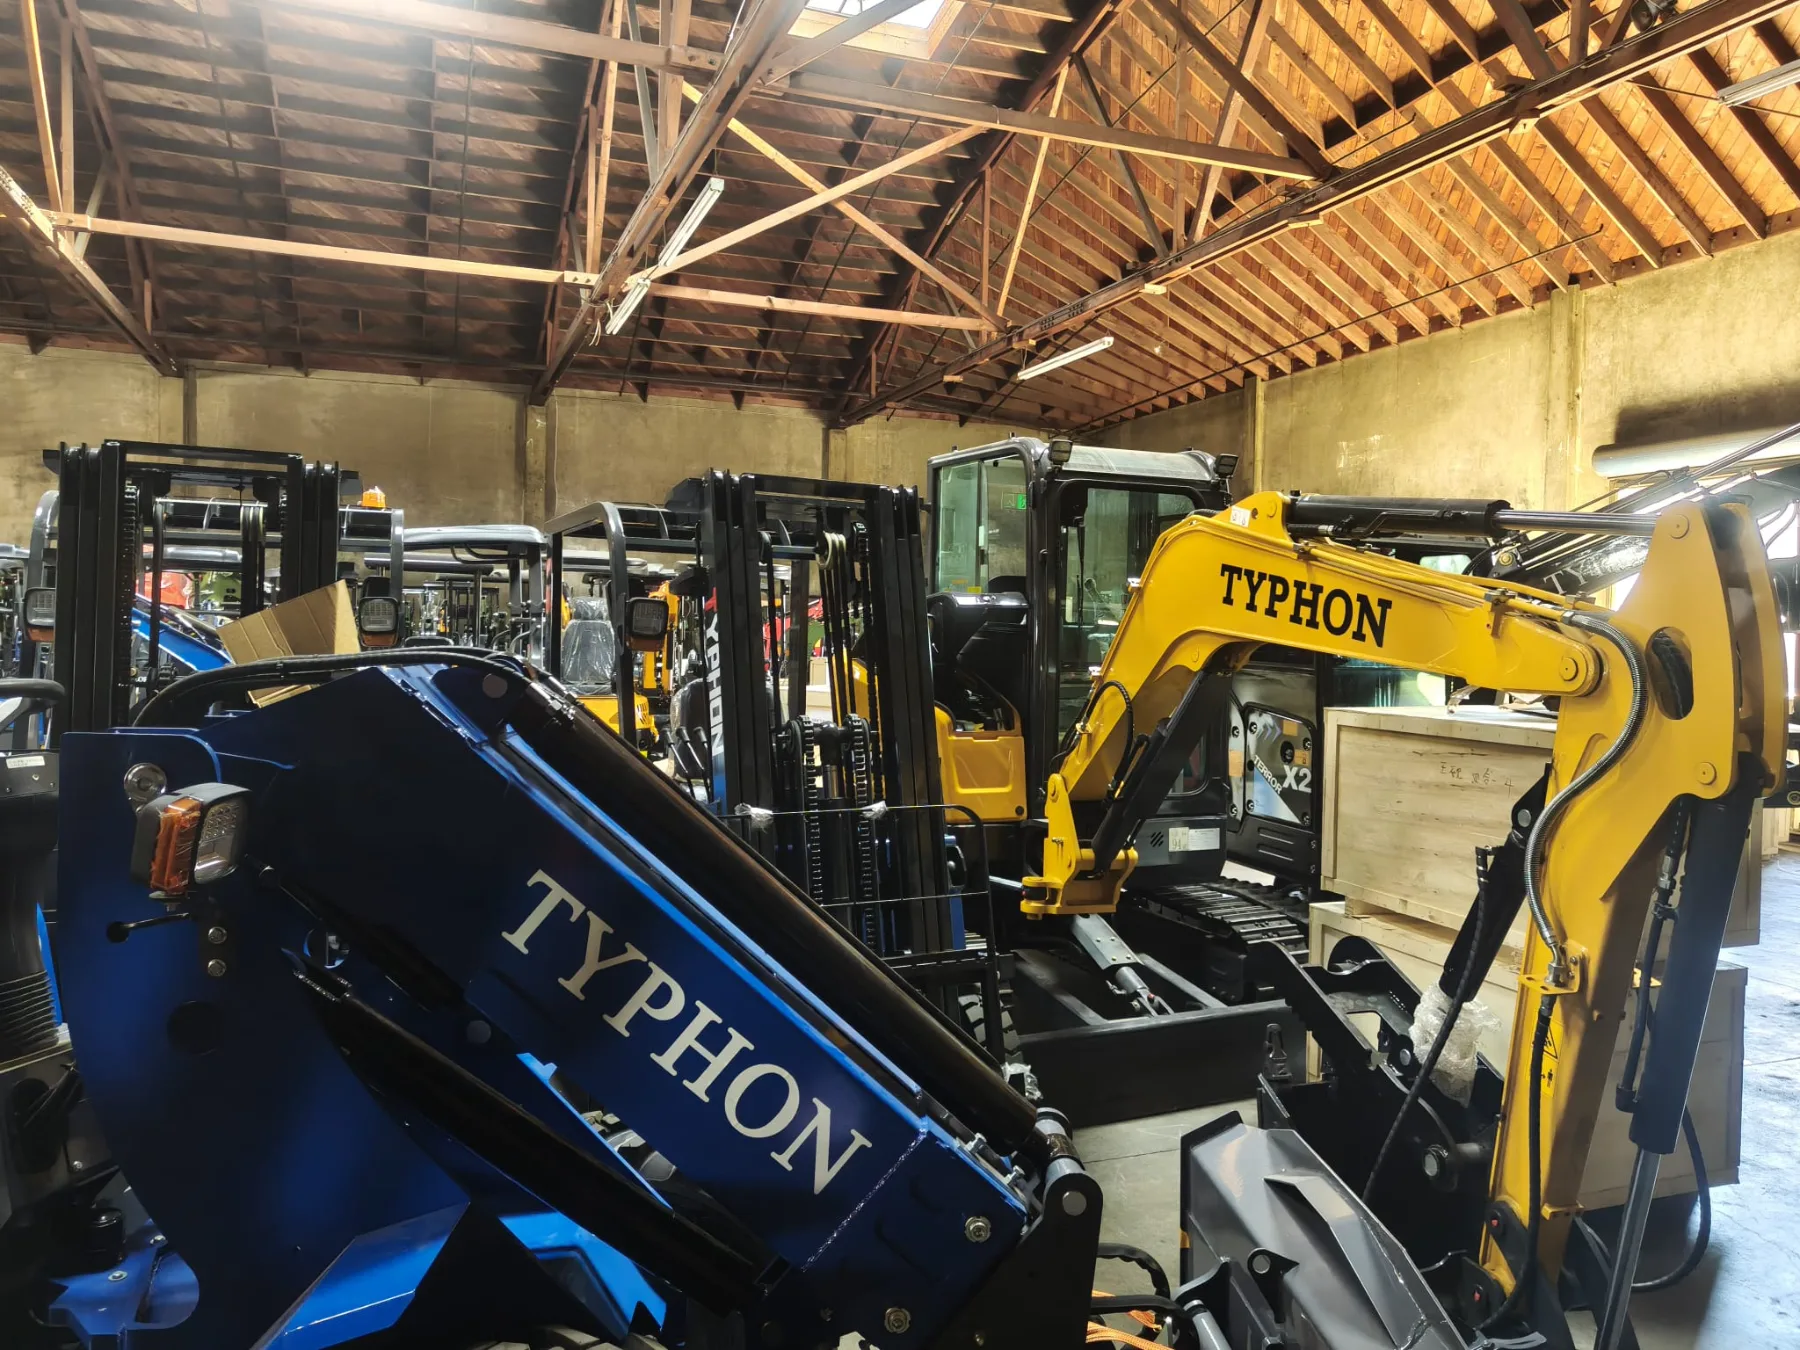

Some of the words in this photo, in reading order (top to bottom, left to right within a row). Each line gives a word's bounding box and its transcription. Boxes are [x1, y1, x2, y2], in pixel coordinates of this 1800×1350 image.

[1220, 563, 1392, 648] TYPHON
[1253, 754, 1283, 795] TERROR
[1282, 764, 1312, 794] X2
[501, 869, 872, 1195] TYPHON
